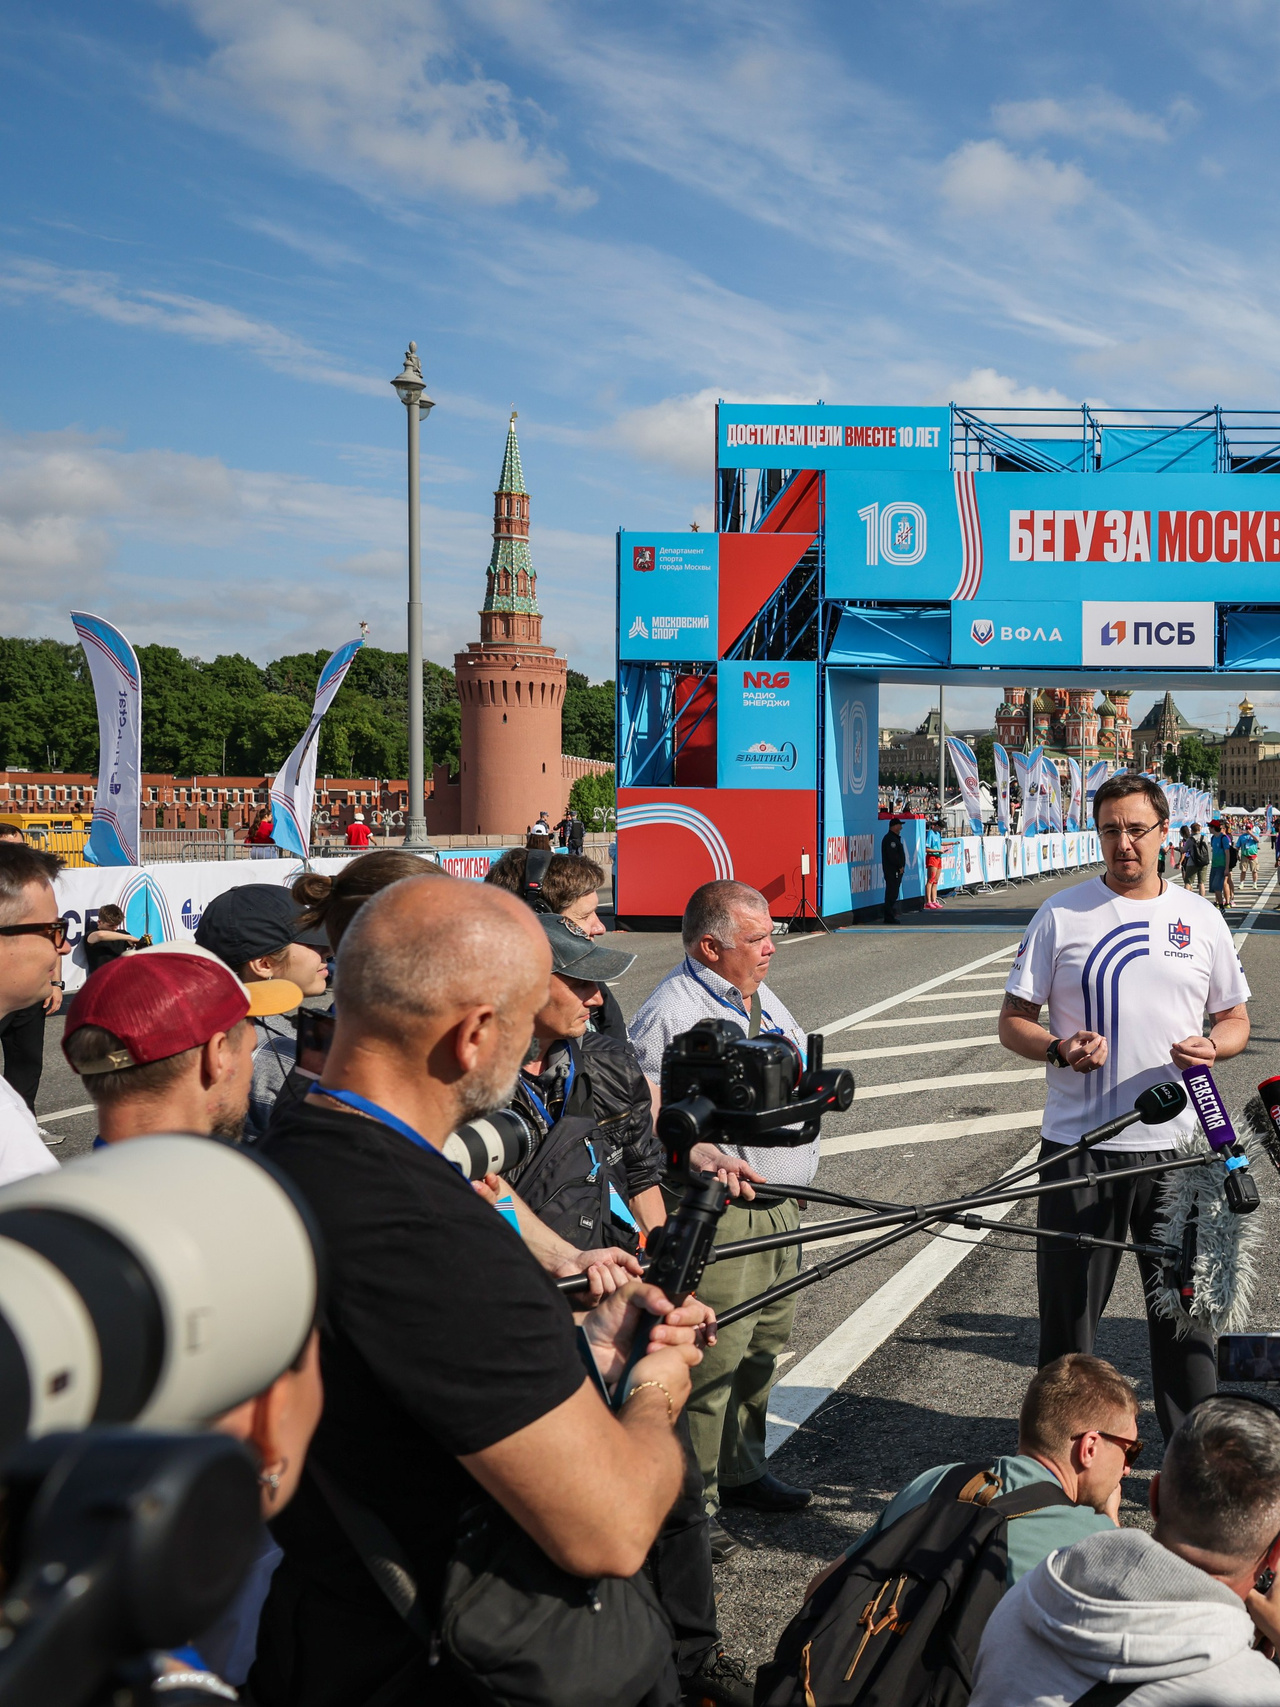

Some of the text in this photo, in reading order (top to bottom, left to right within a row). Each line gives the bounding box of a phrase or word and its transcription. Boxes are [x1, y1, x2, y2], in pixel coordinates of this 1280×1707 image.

[727, 424, 940, 449] ДОСТИГАЕМ ЦЕЛИ ВМЕСТЕ 10 ЛЕТ
[857, 501, 927, 566] 10
[1009, 510, 1098, 561] БЕГУ
[1103, 510, 1151, 562] ЗА
[659, 547, 704, 555] Департамент
[652, 615, 709, 628] МОСКОВСКИЙ
[652, 629, 679, 640] СПОРТ
[1001, 626, 1063, 642] ВФЛА
[1133, 621, 1196, 646] ПСБ
[743, 671, 790, 689] NRG
[743, 692, 776, 700] РАДИО
[743, 699, 790, 707] ЭНЕРДЖИ
[745, 754, 790, 763] БАЛТИКА
[1170, 933, 1189, 941] ПСБ
[1164, 950, 1194, 960] СПОРТ
[1189, 1074, 1226, 1131] ИЗВЕСТИЯ
